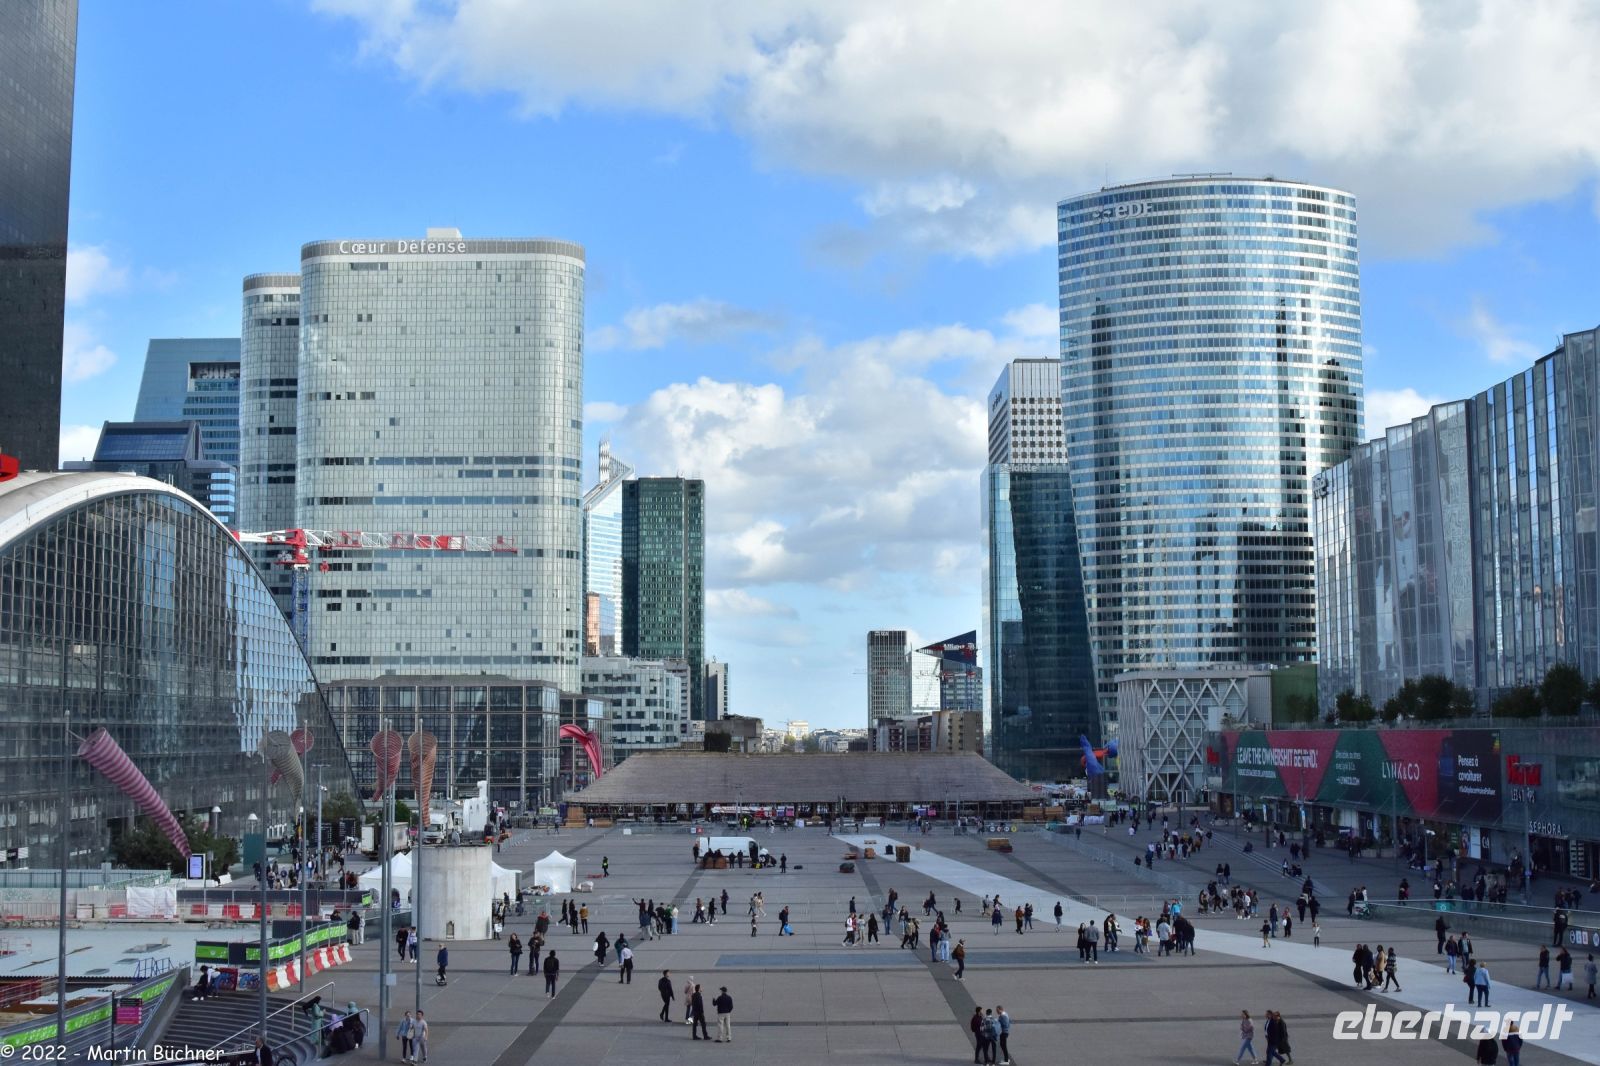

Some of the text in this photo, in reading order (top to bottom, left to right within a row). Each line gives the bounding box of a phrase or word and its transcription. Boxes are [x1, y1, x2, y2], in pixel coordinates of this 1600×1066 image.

[339, 239, 467, 254] Cœur Défense
[1237, 747, 1251, 764] LEAVE
[1252, 748, 1262, 766] THE
[1528, 820, 1563, 836] SEPHORA
